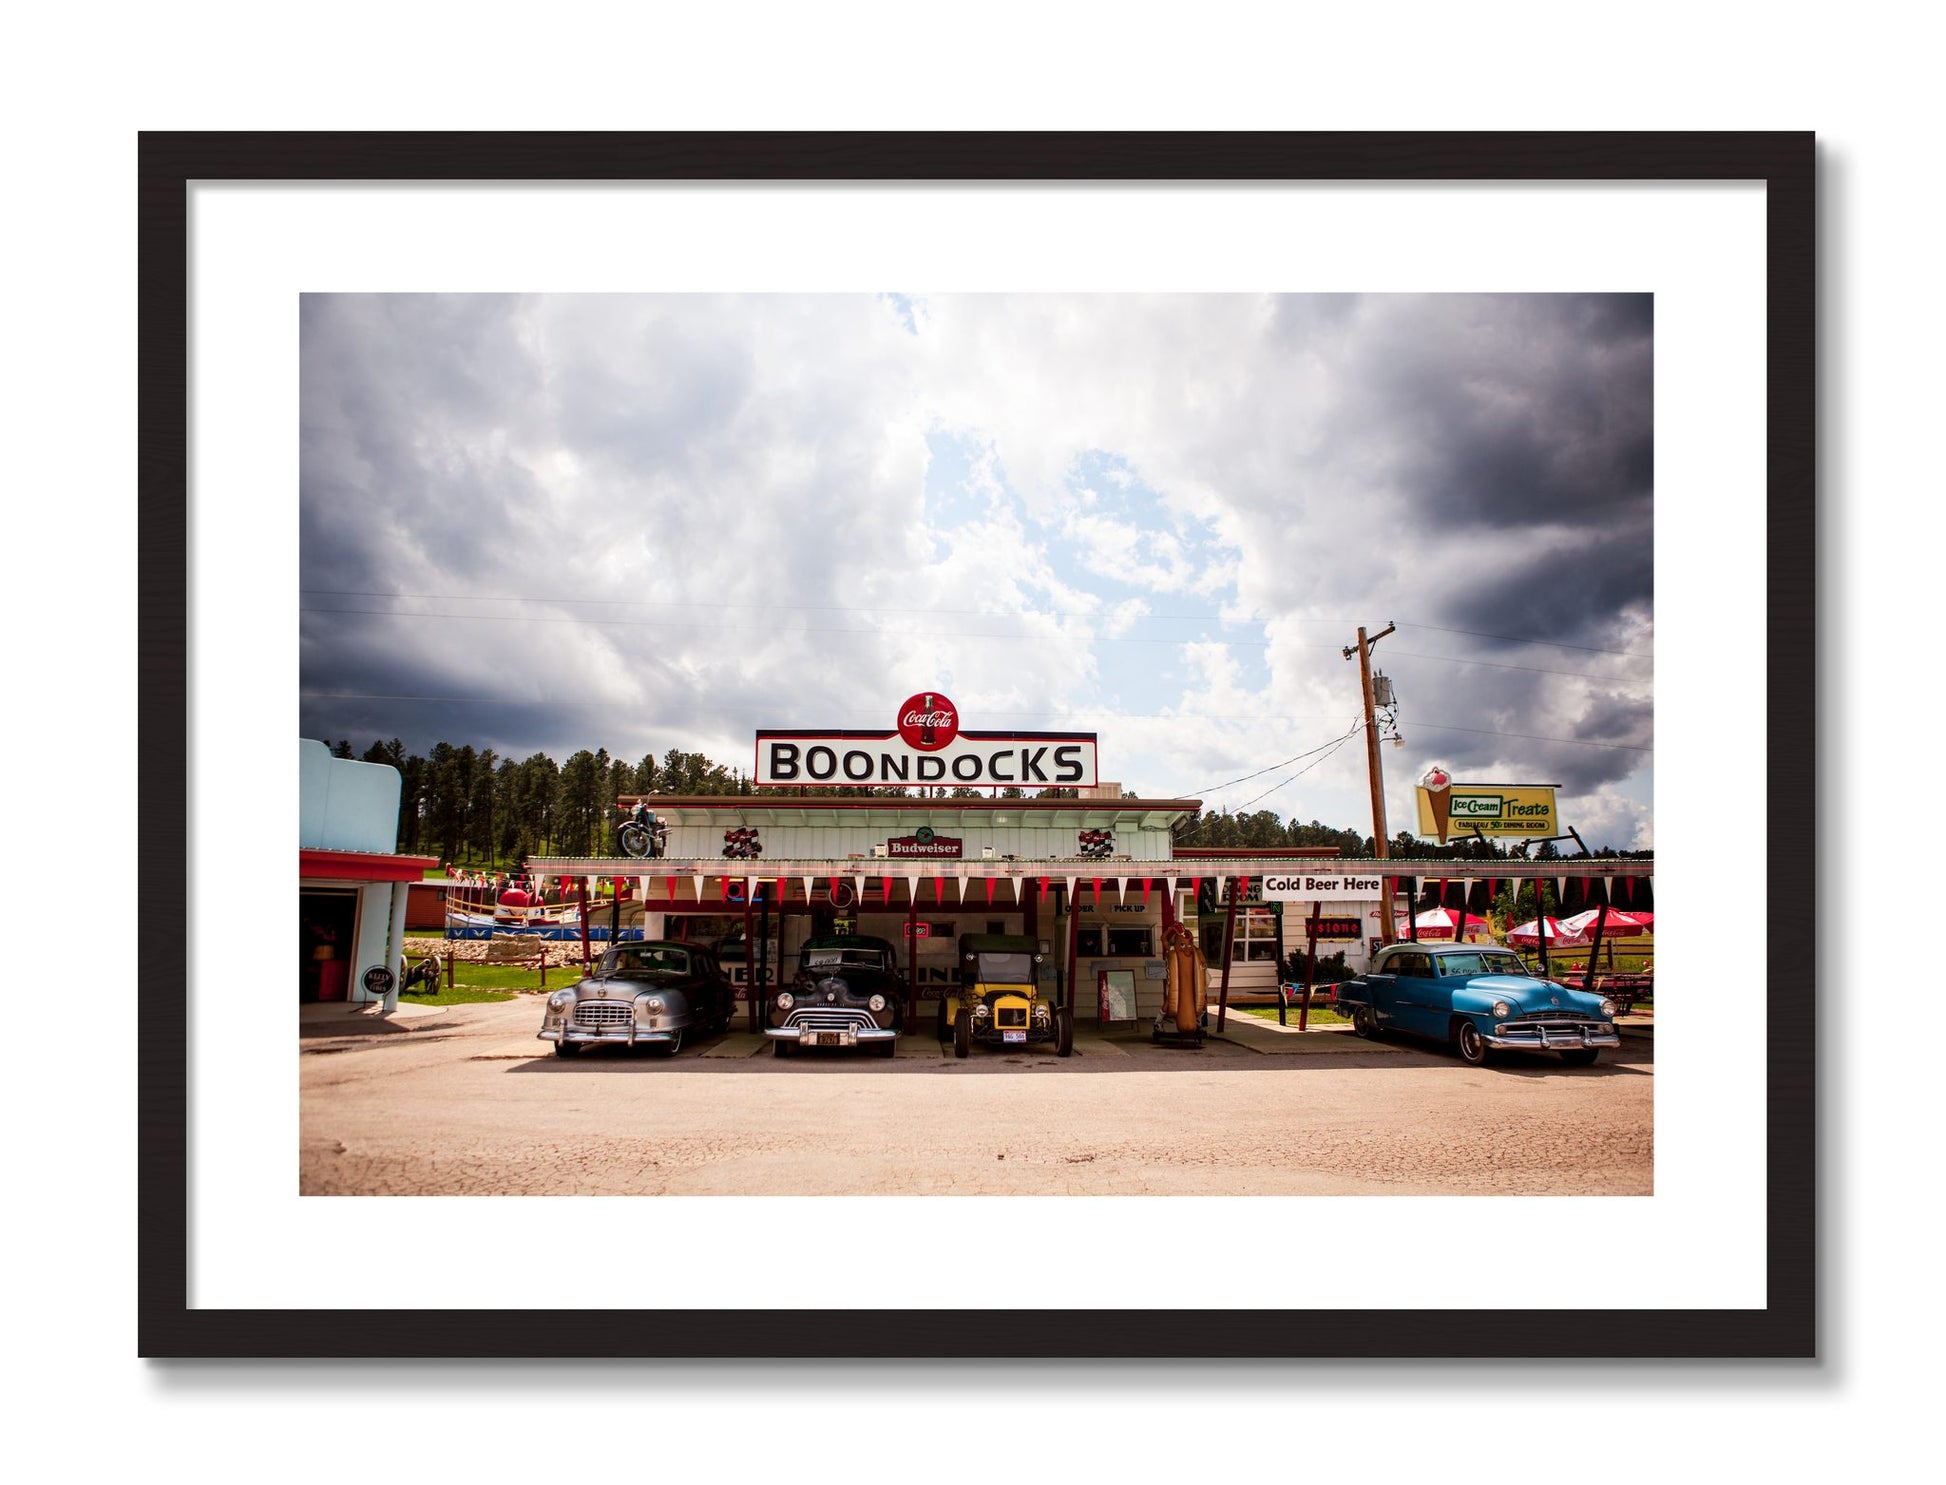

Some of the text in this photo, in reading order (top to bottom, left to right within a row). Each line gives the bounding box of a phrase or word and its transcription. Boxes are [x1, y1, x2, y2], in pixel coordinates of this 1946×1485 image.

[903, 709, 952, 727] Coca-Cola
[770, 743, 1084, 782] BOONDOCKS
[1454, 799, 1549, 817] Ice Cream Treats
[892, 842, 958, 853] Budweiser
[1266, 877, 1379, 891] Cold Beer Here
[1065, 905, 1094, 913] ODER
[1134, 905, 1145, 913] UP
